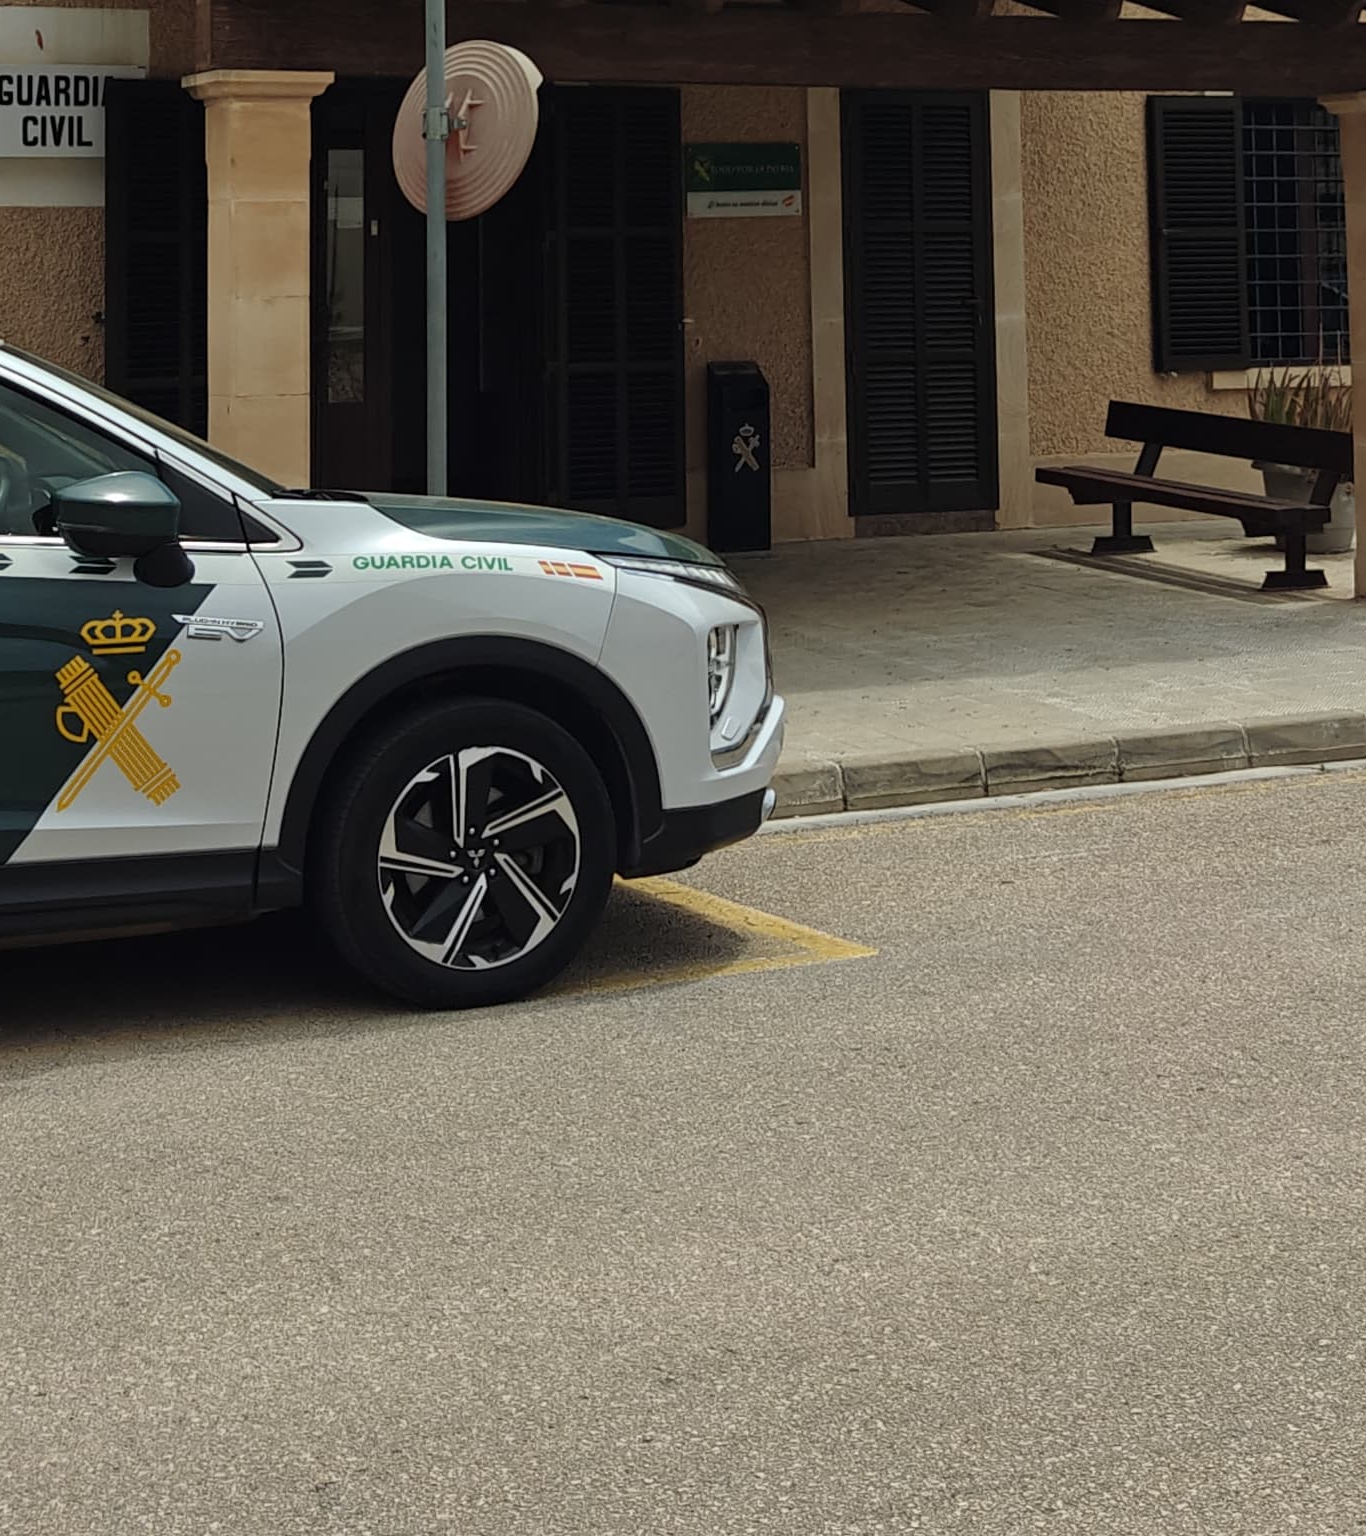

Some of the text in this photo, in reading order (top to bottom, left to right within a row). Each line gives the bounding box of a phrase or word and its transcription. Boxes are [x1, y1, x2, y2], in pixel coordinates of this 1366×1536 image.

[22, 115, 93, 147] CIVIL
[353, 555, 513, 572] GUARDIA CIVIL
[187, 624, 264, 642] EV
